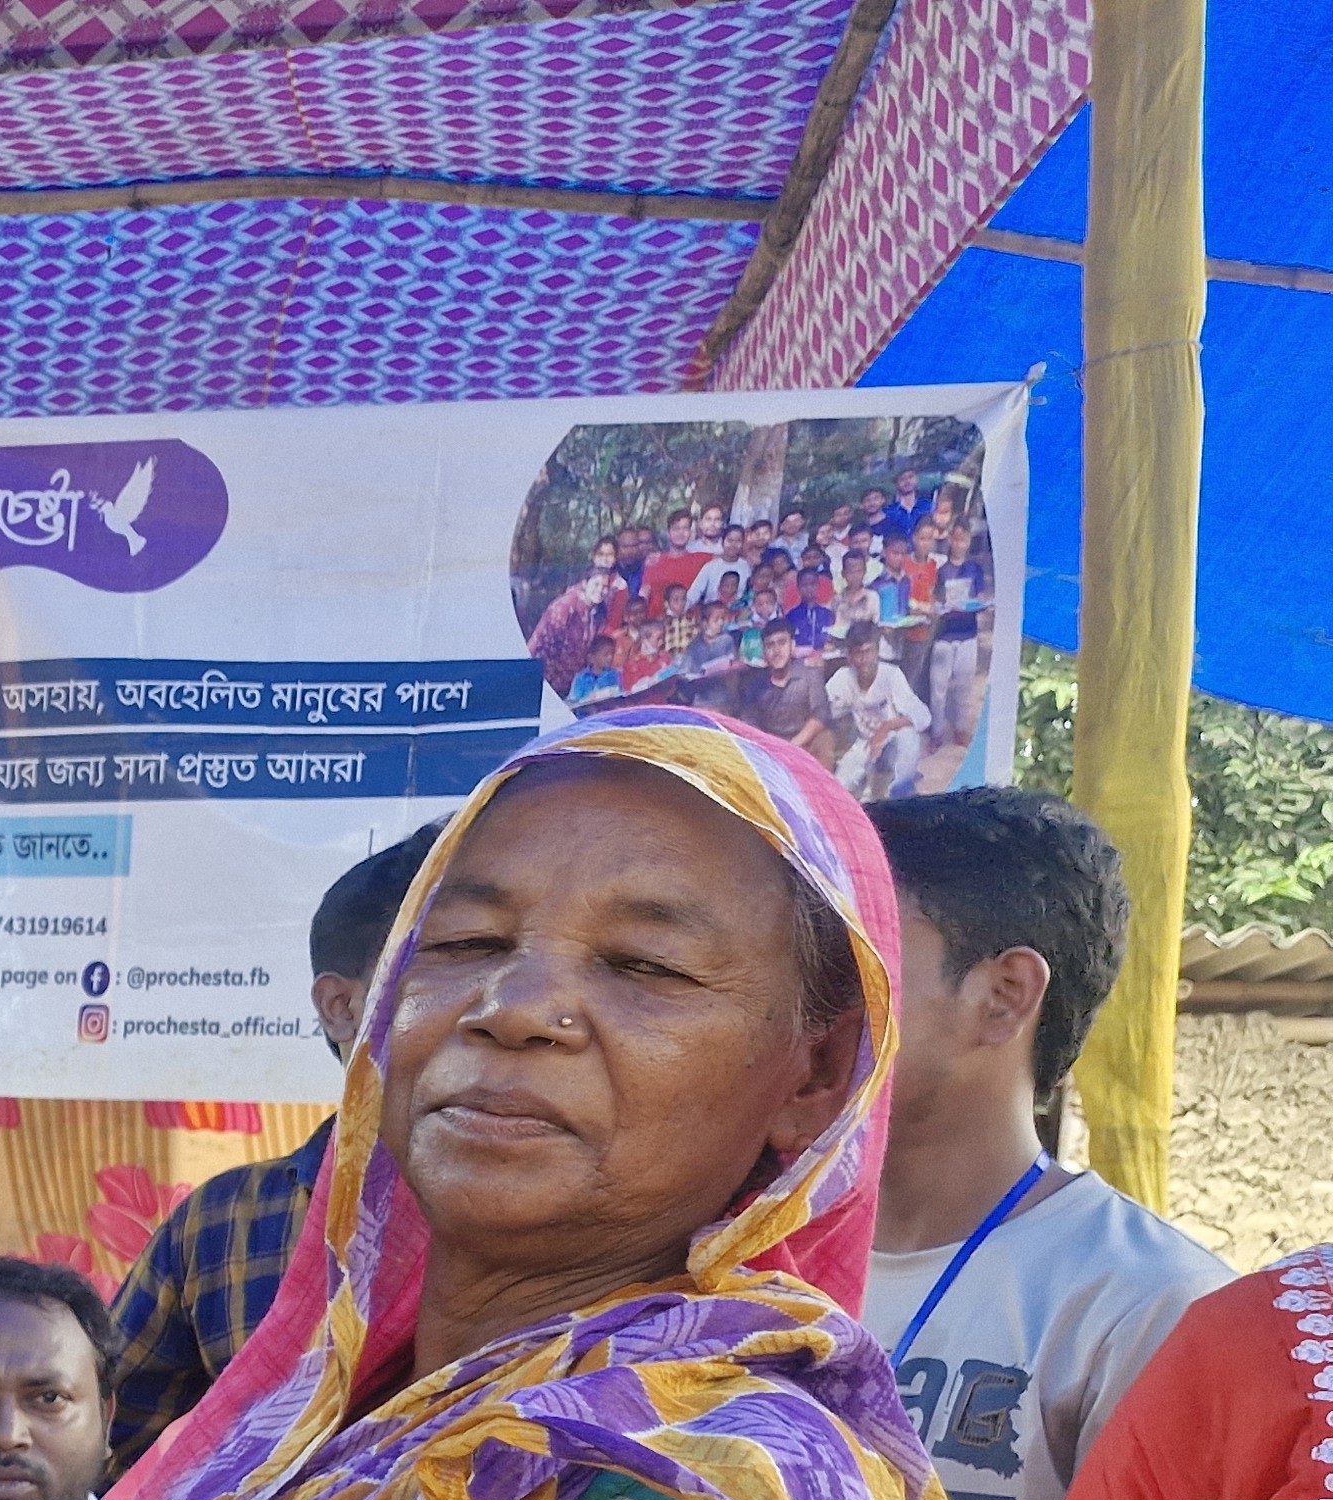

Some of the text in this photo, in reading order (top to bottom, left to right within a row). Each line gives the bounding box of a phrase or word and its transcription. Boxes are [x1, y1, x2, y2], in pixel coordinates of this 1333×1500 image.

[2, 679, 105, 716] অসহায়,
[115, 669, 264, 712] অবহেলিত
[271, 680, 387, 723] মানুষের
[395, 680, 473, 714] পাশে
[46, 756, 107, 789] জন্য
[113, 751, 170, 785] সদা
[176, 751, 260, 789] প্রস্তুত
[266, 751, 368, 784] আমরা
[1, 968, 49, 989] page
[54, 970, 77, 985] on
[126, 967, 270, 991] @prochesta.fb
